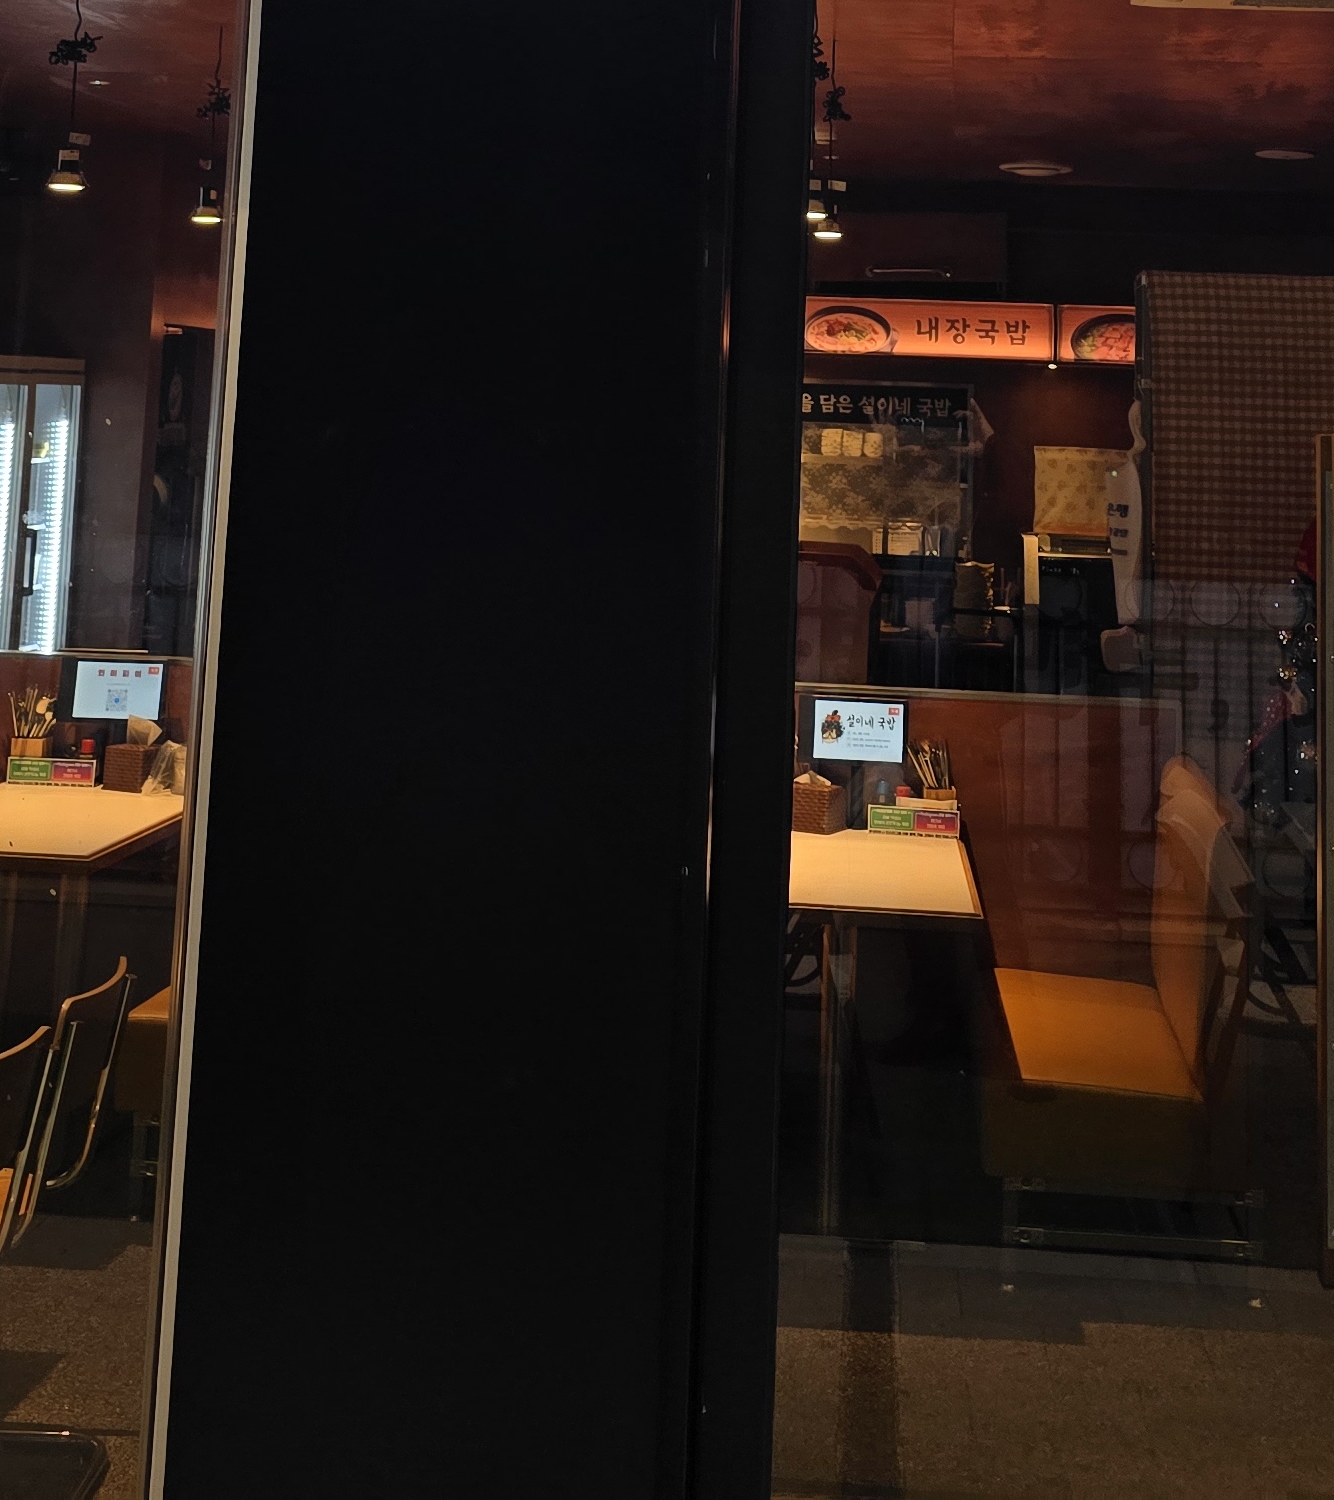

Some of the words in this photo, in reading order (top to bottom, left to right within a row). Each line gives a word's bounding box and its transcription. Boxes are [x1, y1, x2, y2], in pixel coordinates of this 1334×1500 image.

[916, 316, 1030, 345] 내장국밥
[819, 394, 854, 414] 담은
[858, 395, 912, 416] 설이네
[917, 397, 952, 417] 국밥
[846, 714, 874, 728] 설이네
[877, 716, 896, 730] 국밥
